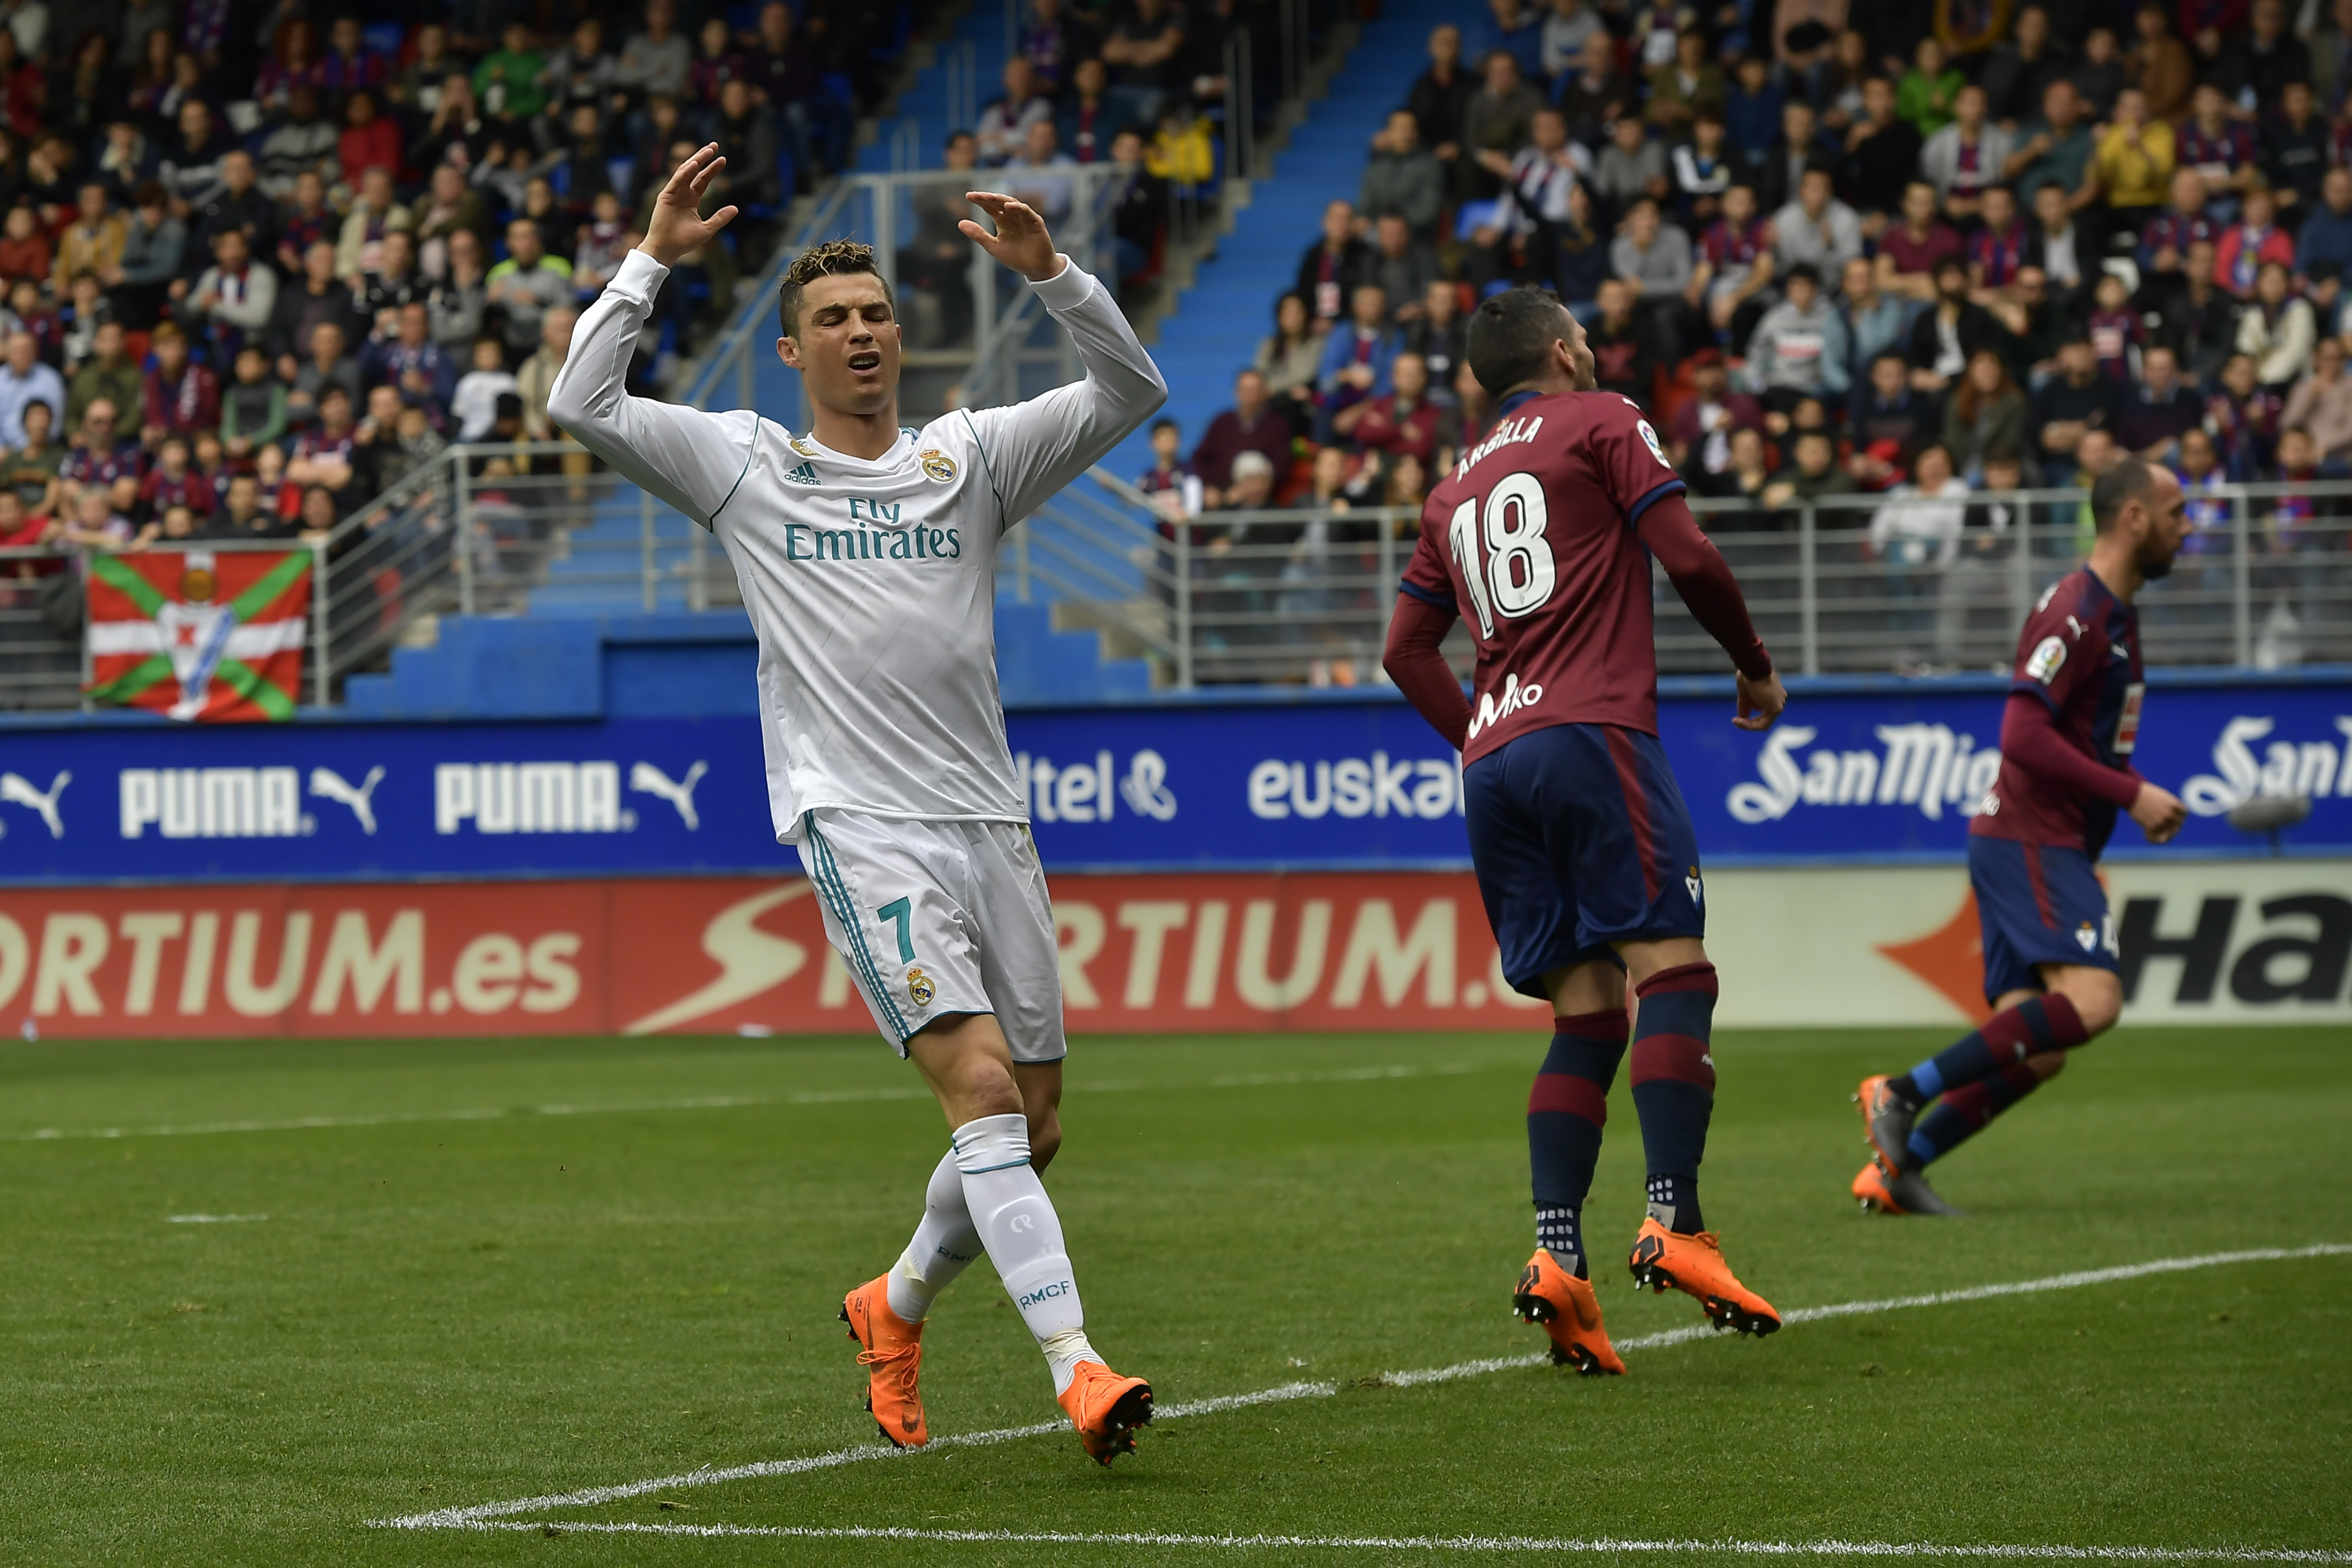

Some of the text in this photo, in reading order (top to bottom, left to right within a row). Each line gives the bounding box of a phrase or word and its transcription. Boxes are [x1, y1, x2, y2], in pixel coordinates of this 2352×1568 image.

[784, 474, 821, 485] adidas
[848, 497, 900, 524] Fly
[784, 522, 960, 560] Emirates
[1448, 471, 1557, 641] 18
[120, 766, 300, 839] PUMA
[435, 760, 620, 834] PUMA
[876, 895, 916, 966] 7
[1019, 1280, 1070, 1310] RMCF
